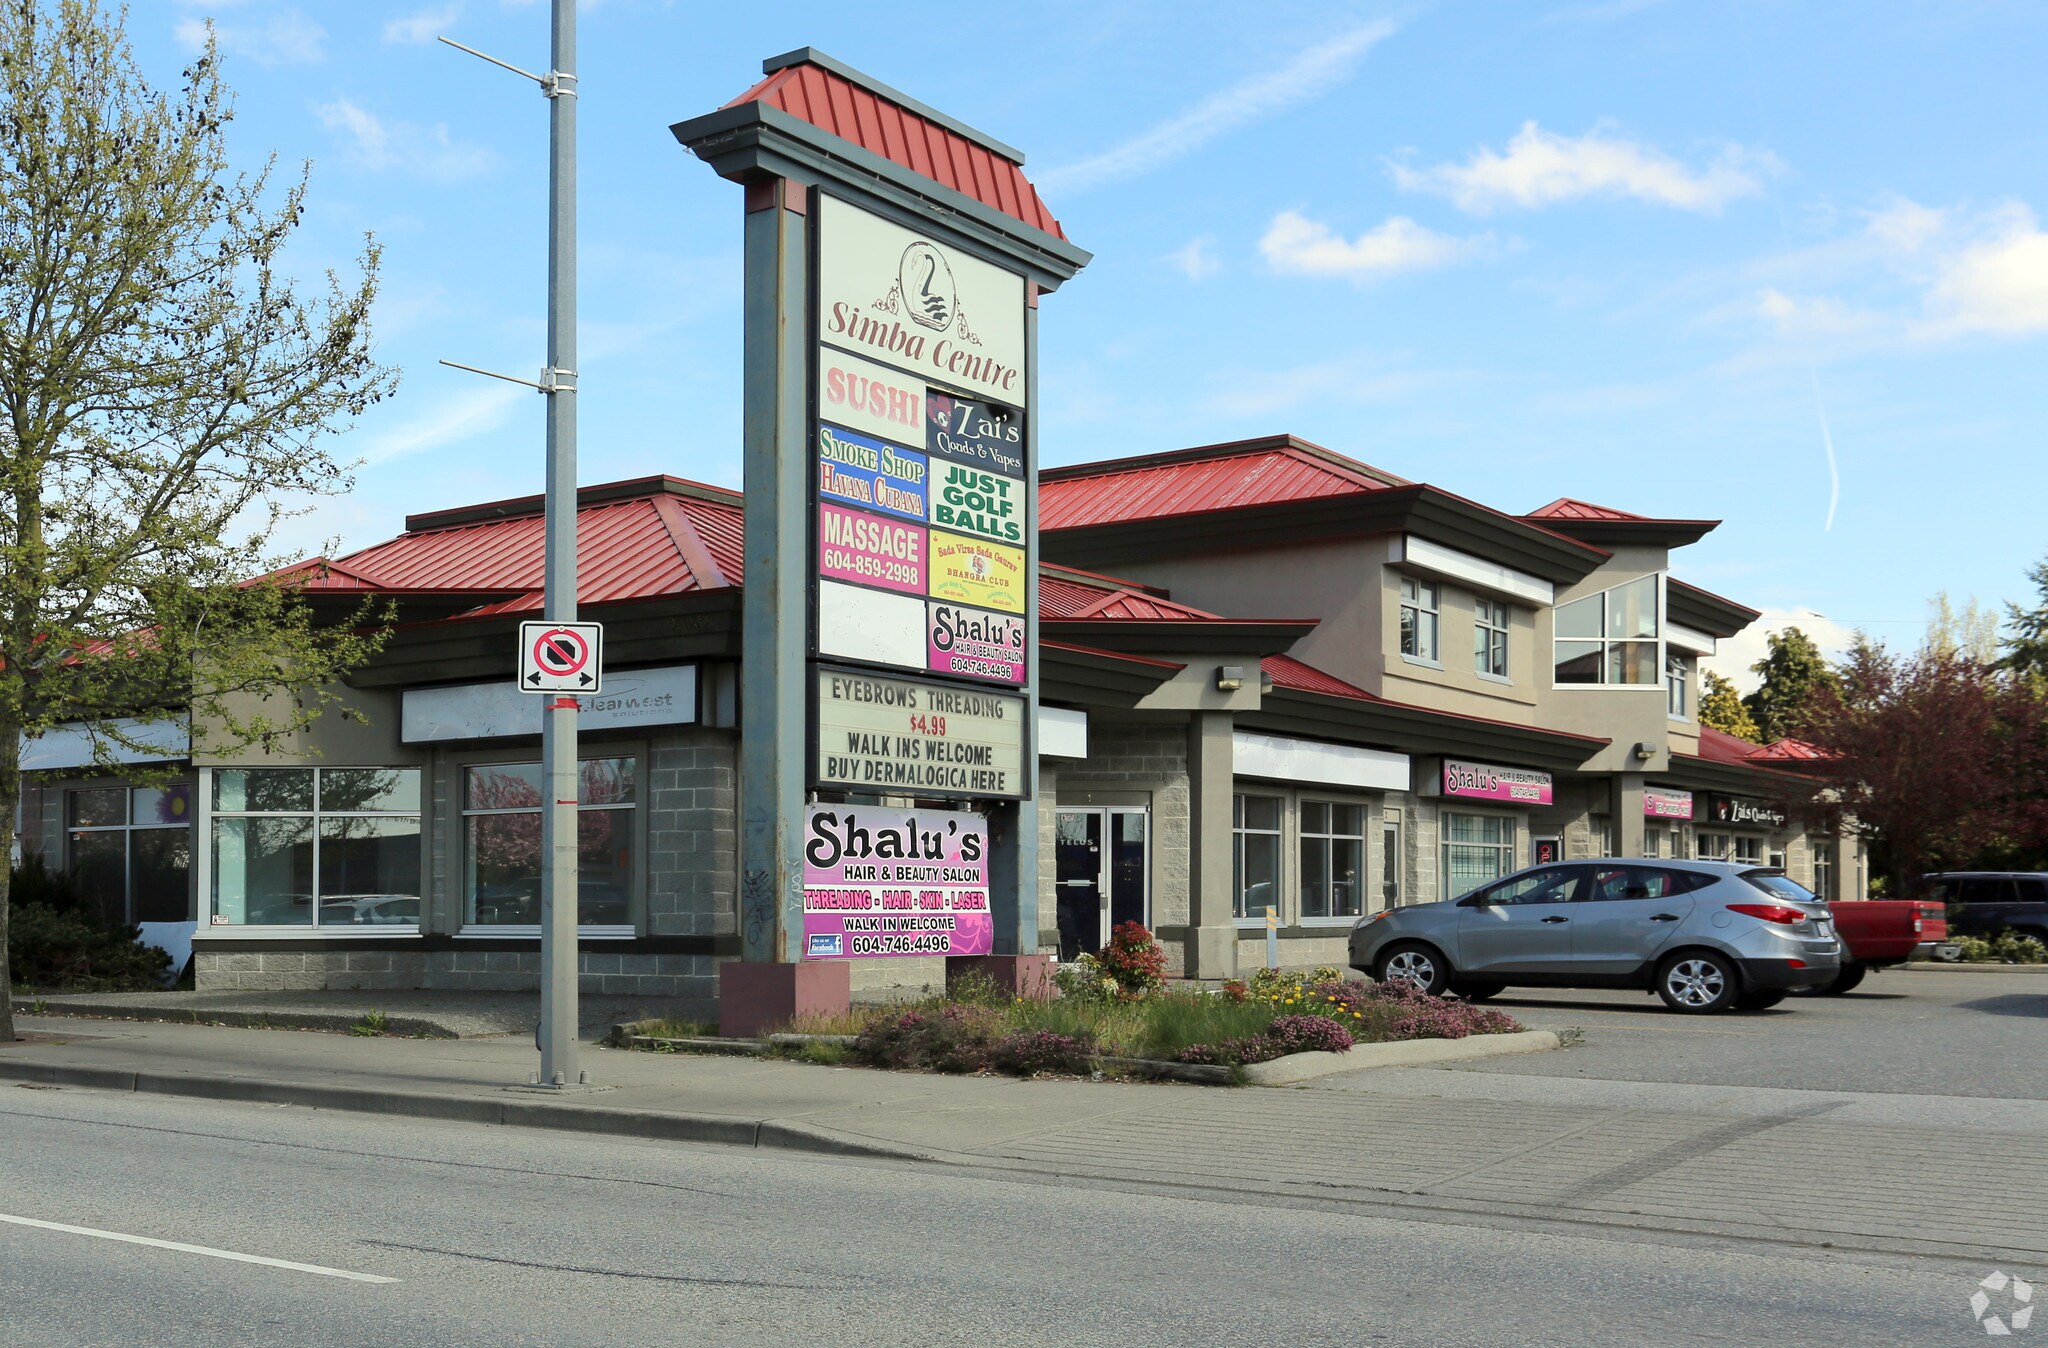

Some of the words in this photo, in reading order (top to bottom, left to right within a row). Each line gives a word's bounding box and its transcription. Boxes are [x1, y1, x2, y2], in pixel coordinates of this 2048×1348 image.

[828, 302, 925, 361] Simba
[932, 340, 1017, 391] Centre
[827, 367, 920, 429] SUSHI
[954, 400, 1020, 443] Zai's
[820, 428, 878, 471] SMOKE
[881, 446, 925, 484] SHOP
[937, 432, 975, 454] Clouds
[977, 444, 987, 459] &
[989, 447, 1021, 471] Vapes
[820, 463, 871, 502] HAVANA
[874, 478, 924, 516] CUBANA
[945, 466, 1011, 498] JUST
[943, 487, 1013, 518] GOLF
[824, 511, 919, 563] MASSAGE
[936, 504, 1021, 541] BALLS
[824, 549, 919, 586] 604-859-2998
[938, 545, 955, 557] Sada
[976, 546, 993, 559] Sada
[947, 568, 986, 583] BHANGRA
[989, 576, 1010, 587] CLUB
[933, 606, 1022, 651] Shalu's
[951, 658, 1012, 679] 604.746.4496
[955, 642, 972, 655] HAIR
[978, 646, 1002, 661] BEAUTY
[1003, 649, 1023, 664] SALON
[832, 677, 917, 709] EYEBROWS
[927, 690, 1004, 719] THREADING
[910, 714, 946, 737] $4.99
[848, 732, 890, 757] WALK
[896, 738, 920, 760] INS
[925, 740, 992, 766] WELCOME
[828, 757, 860, 780] BUY
[864, 760, 967, 789] DERMALOGICA
[971, 770, 1005, 791] HERE
[1448, 764, 1498, 792] Shalu's
[805, 811, 982, 868] Shalu's
[1060, 838, 1094, 846] TELUS
[1541, 845, 1550, 864] OP
[844, 865, 876, 881] HAIR
[881, 866, 891, 880] &
[896, 866, 939, 881] BEAUTY
[942, 867, 981, 882] SALON
[804, 889, 872, 910] THREADING
[882, 890, 912, 910] HAIR
[919, 890, 944, 910] SKIN
[951, 891, 986, 910] LASER
[843, 917, 878, 931] WALK
[883, 917, 897, 931] IN
[900, 917, 956, 931] WELCOME
[852, 935, 949, 954] 604.746.4496
